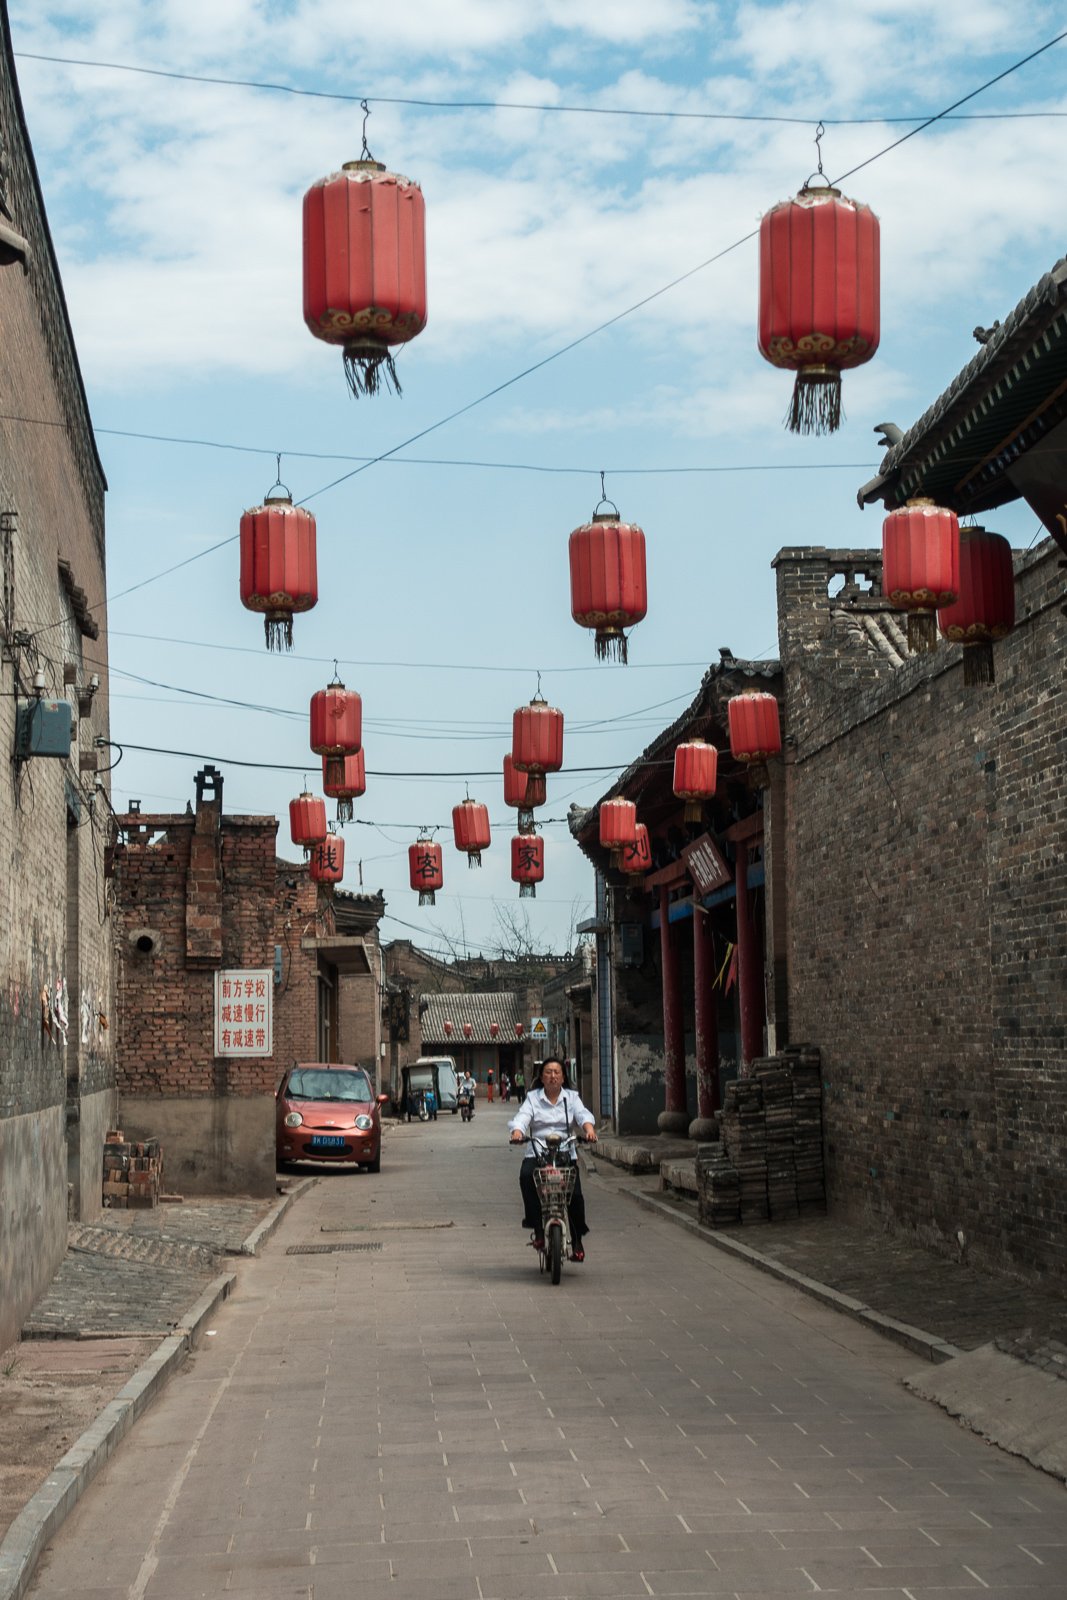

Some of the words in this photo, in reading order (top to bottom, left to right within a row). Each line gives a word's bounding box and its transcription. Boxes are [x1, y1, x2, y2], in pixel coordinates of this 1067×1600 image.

[315, 846, 339, 873] 栈
[416, 852, 439, 879] 客
[517, 845, 541, 871] 家
[222, 979, 265, 998] 前方学校
[222, 1004, 265, 1023] 减速慢行
[222, 1029, 265, 1048] 有减速带
